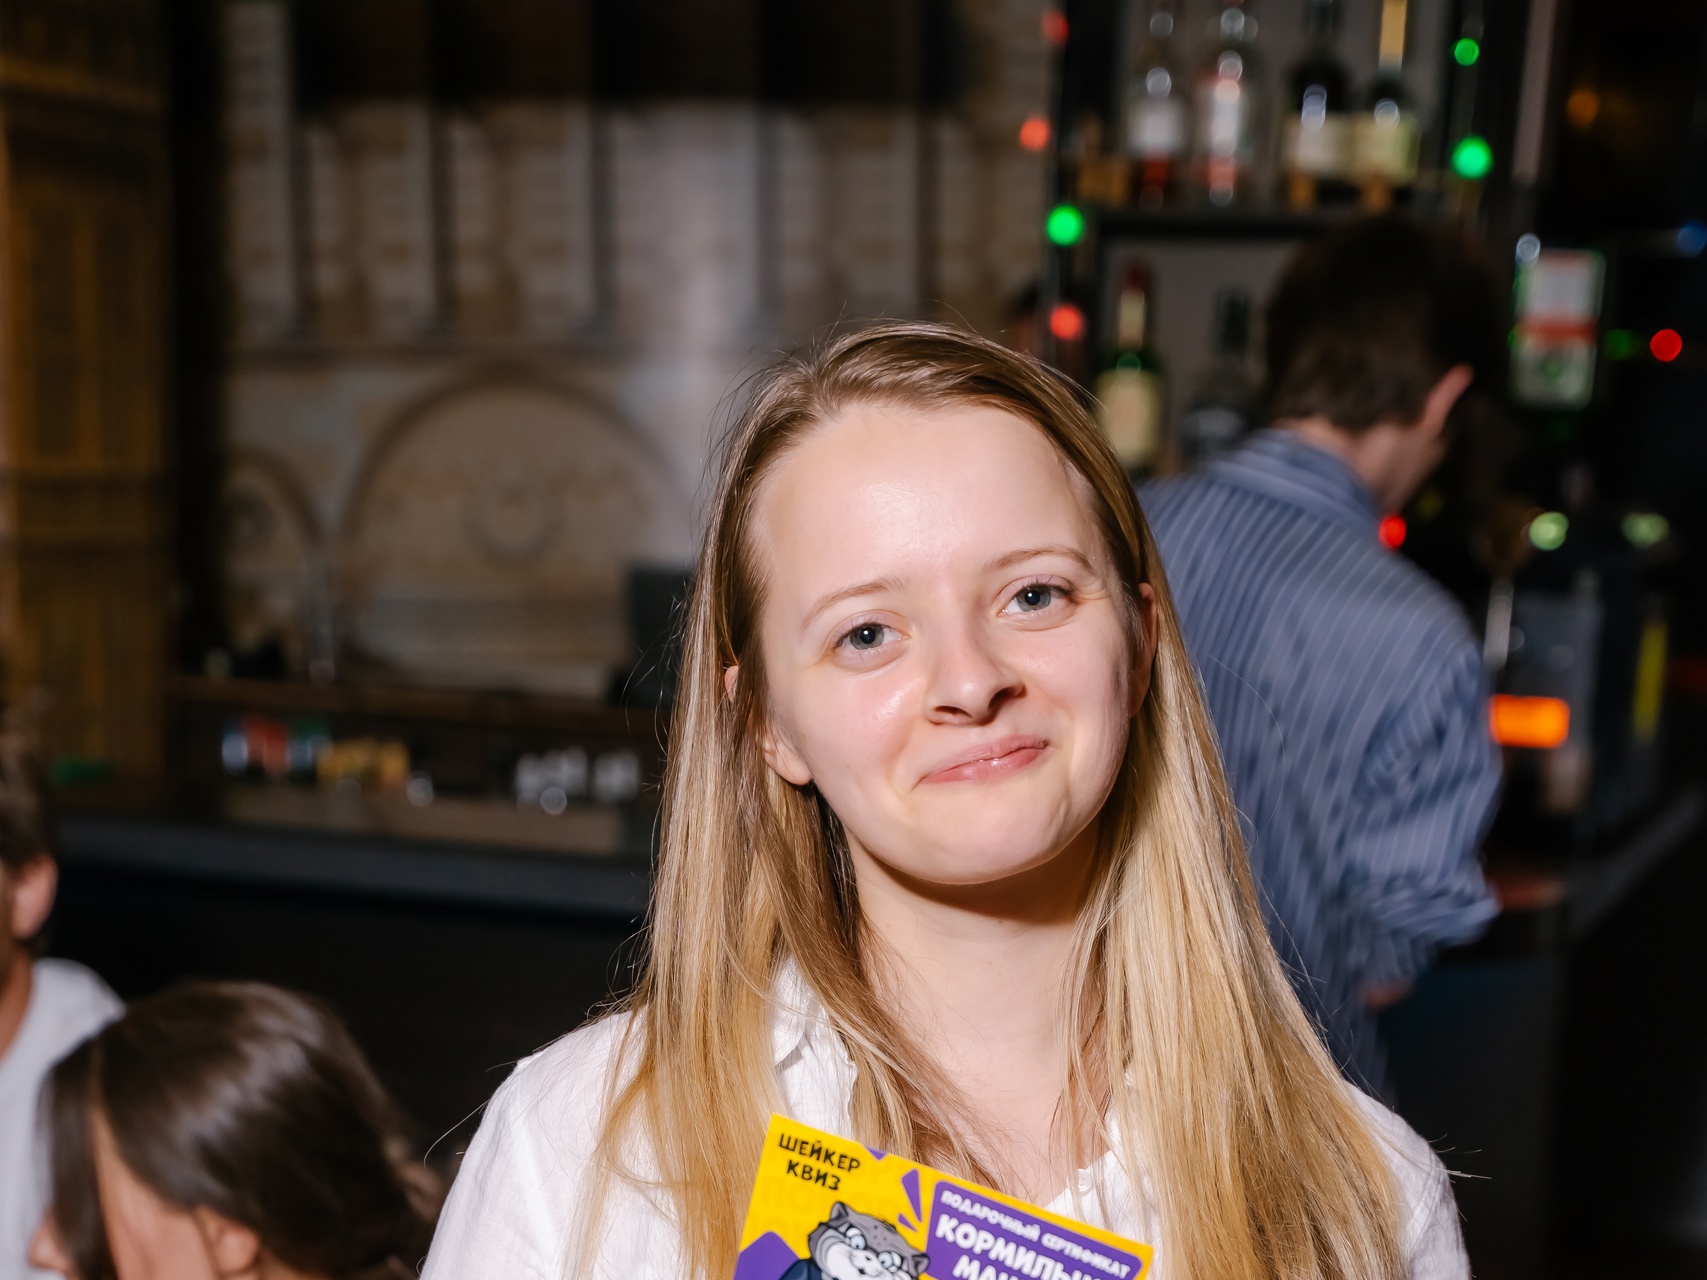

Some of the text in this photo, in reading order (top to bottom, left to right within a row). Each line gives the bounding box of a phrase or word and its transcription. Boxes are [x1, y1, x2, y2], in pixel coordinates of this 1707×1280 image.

[779, 1133, 861, 1172] ШЕЙКЕР
[786, 1159, 841, 1191] КВИЗ
[940, 1189, 1132, 1280] ПОДАРОЧНЫЙ СЕРТИФИКАТ
